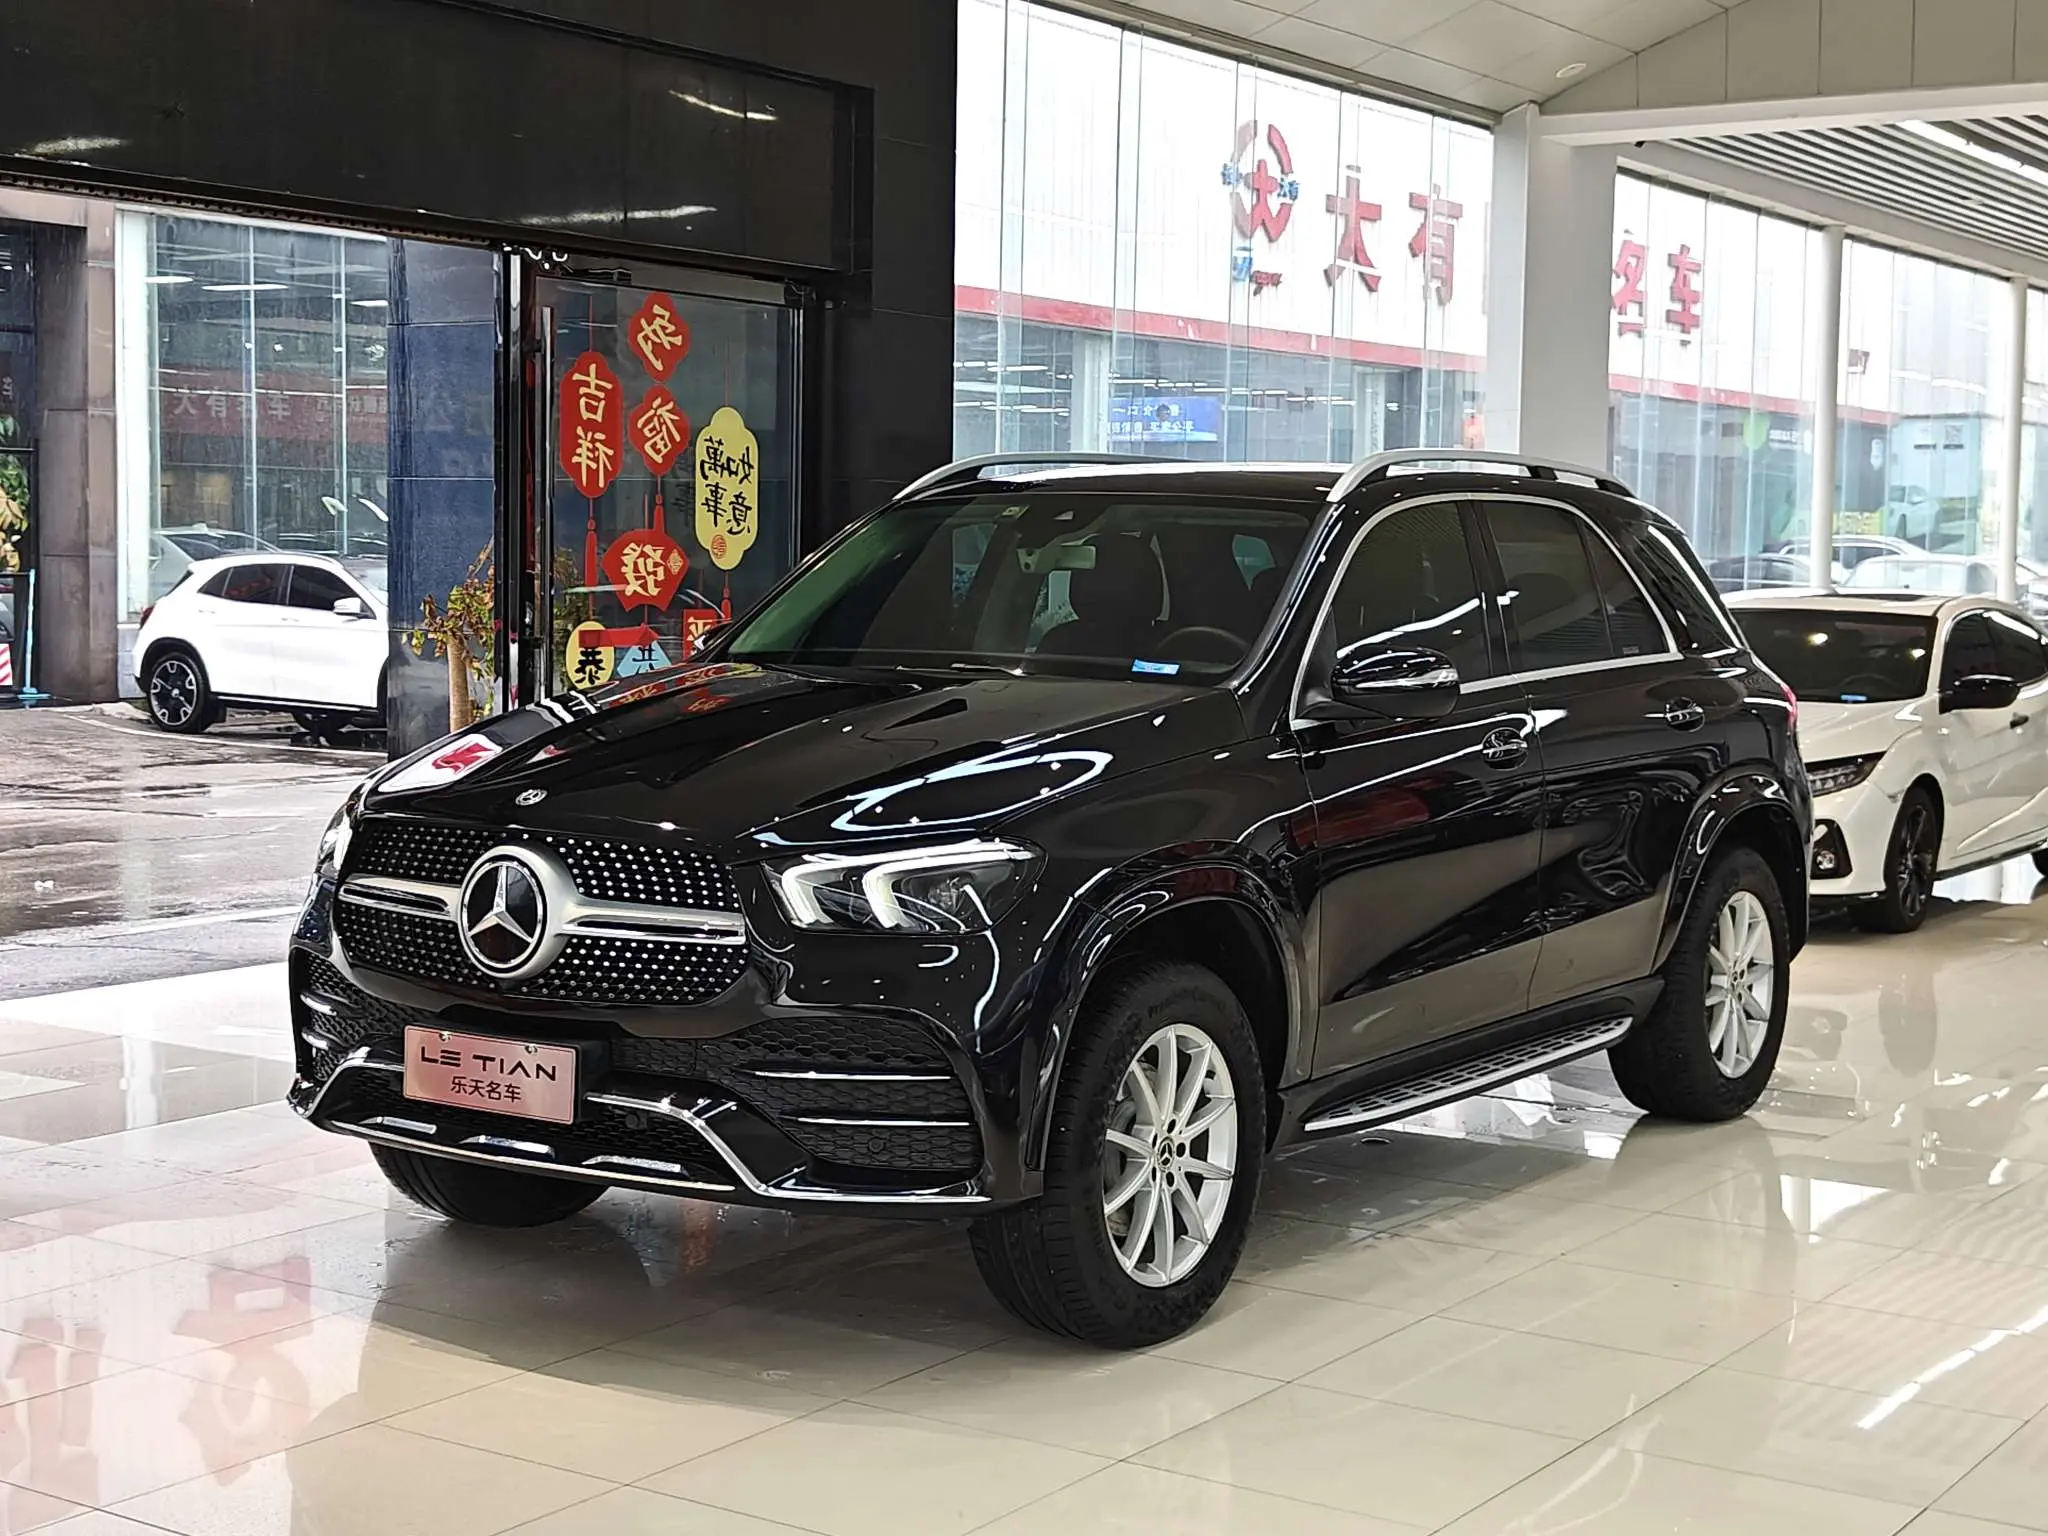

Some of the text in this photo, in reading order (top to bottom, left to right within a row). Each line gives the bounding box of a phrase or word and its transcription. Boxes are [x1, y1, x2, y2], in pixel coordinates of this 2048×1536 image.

[421, 1046, 557, 1082] LE TIAN
[450, 1076, 522, 1103] 乐天名车
